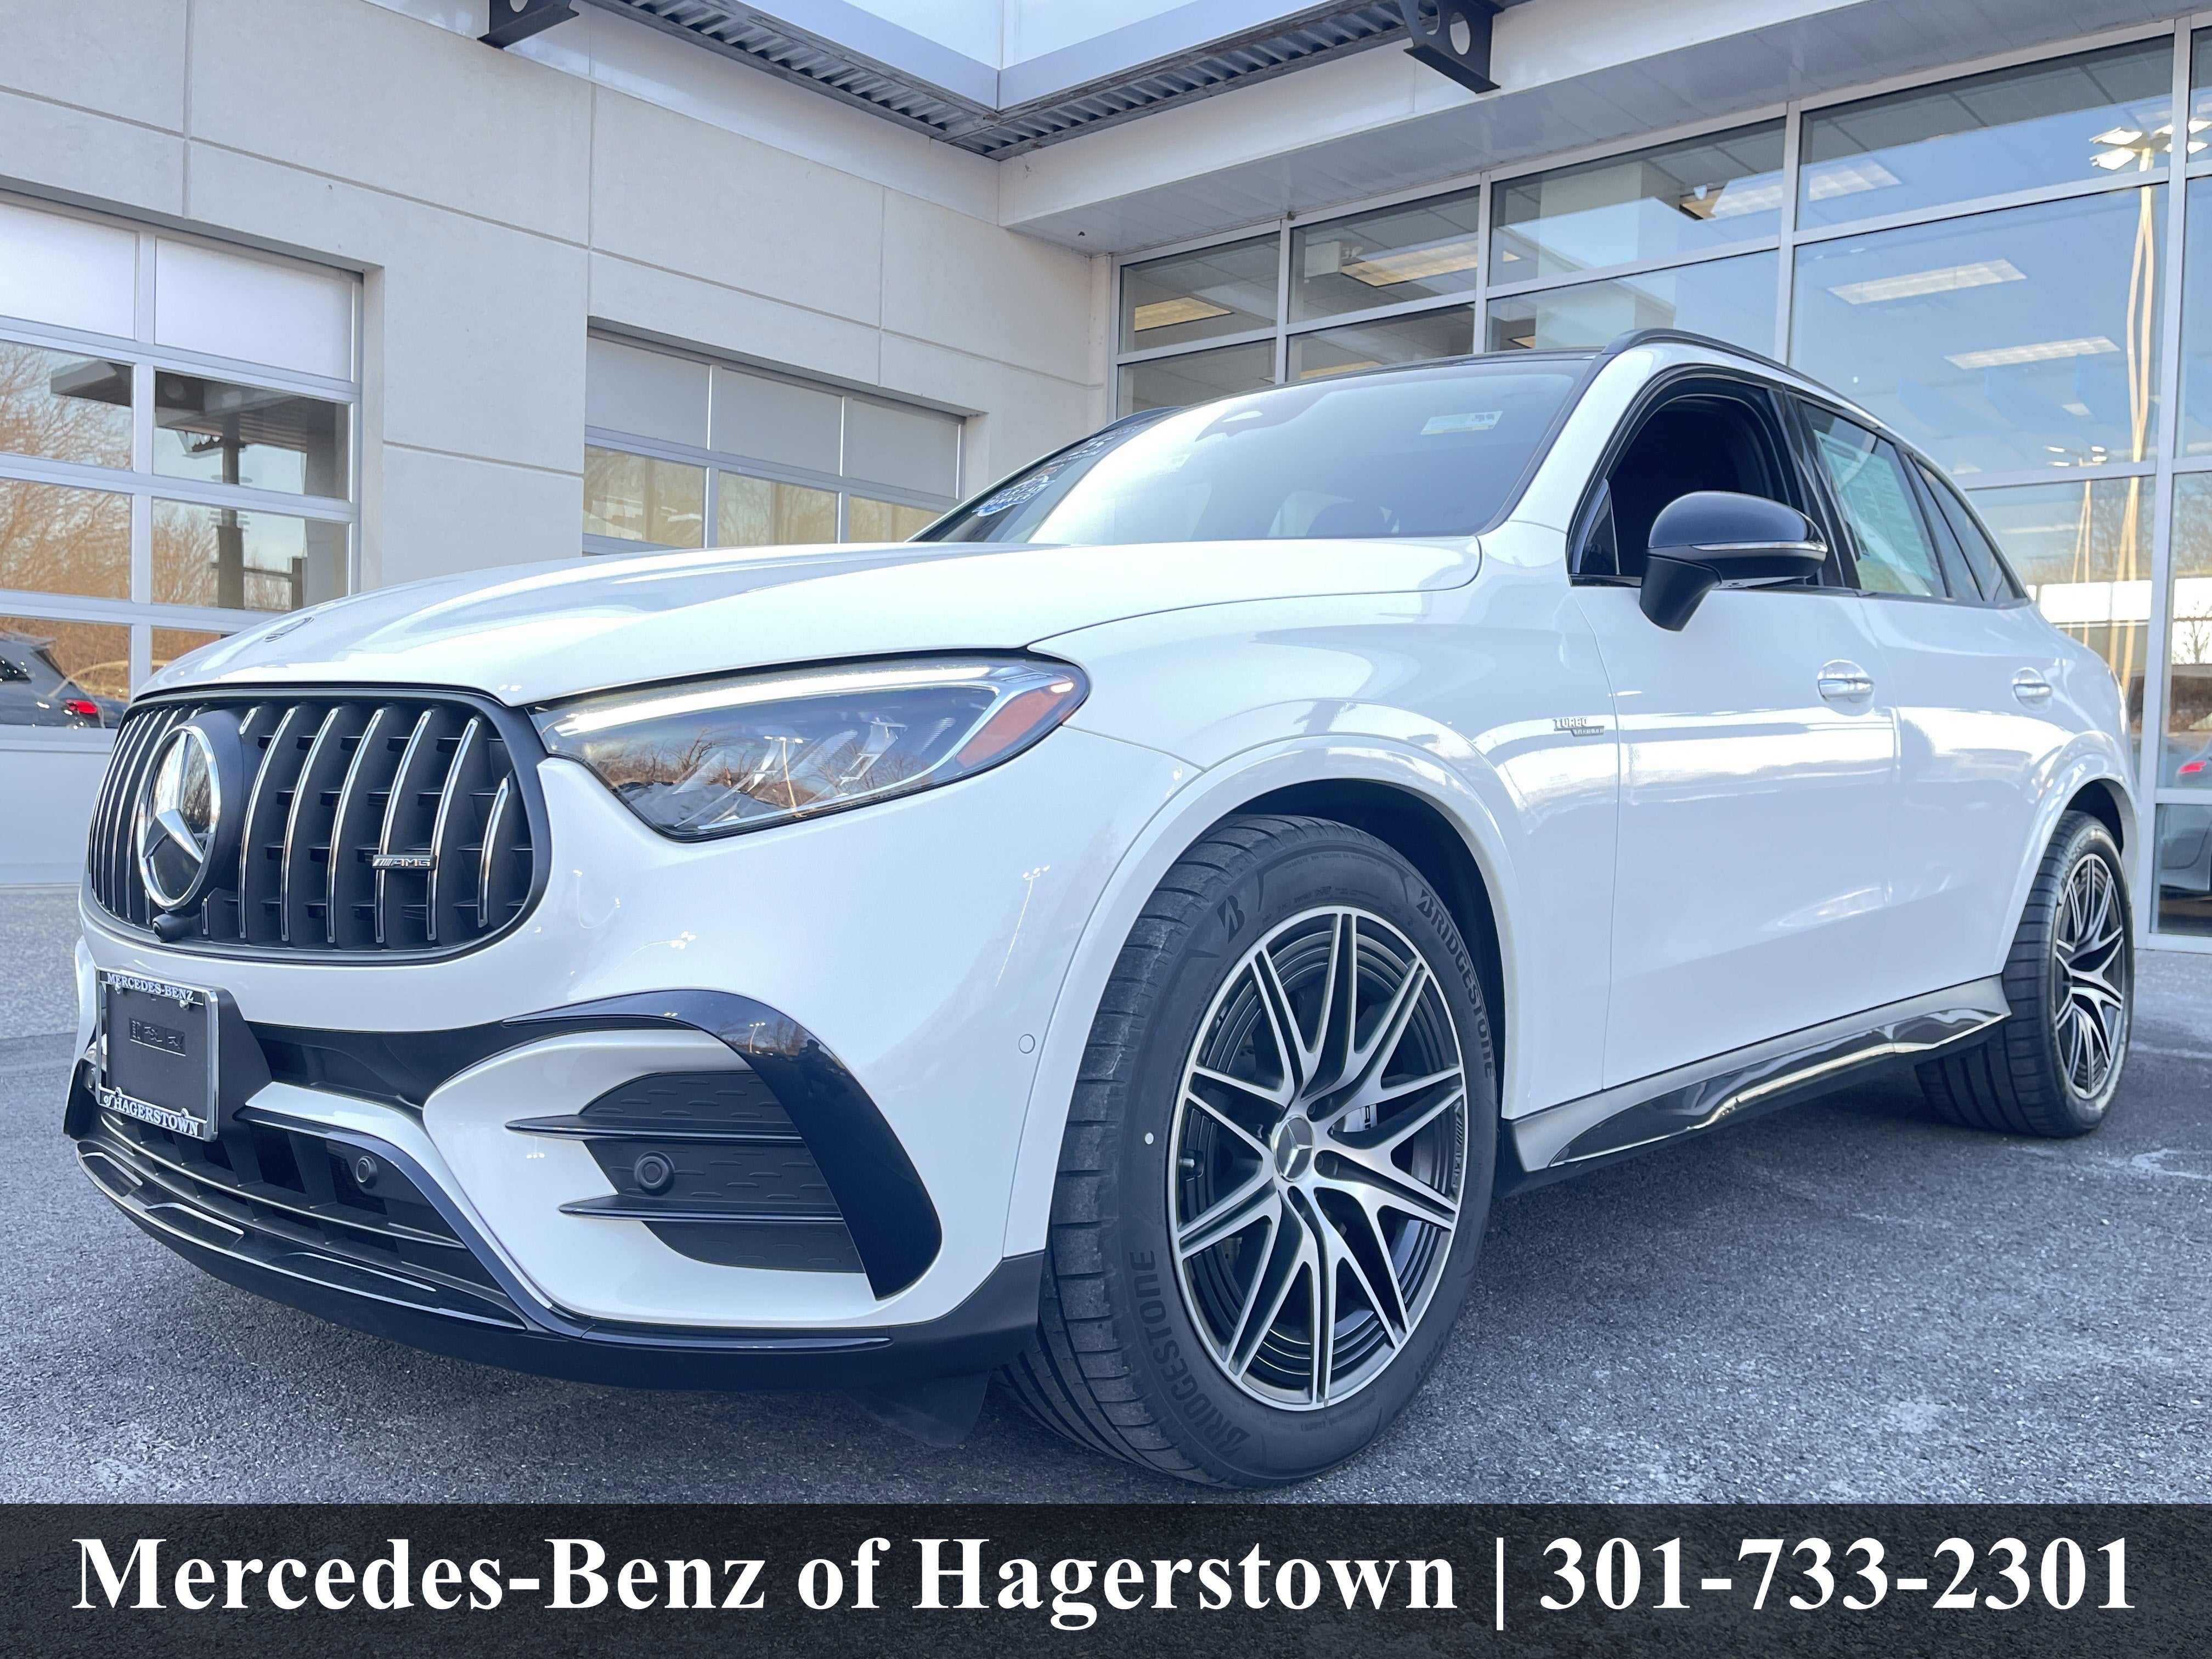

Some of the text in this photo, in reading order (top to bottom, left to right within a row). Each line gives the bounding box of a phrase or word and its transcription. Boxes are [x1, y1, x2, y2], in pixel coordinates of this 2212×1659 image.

[107, 973, 194, 1001] MERCEDES-BENZ
[1417, 888, 1494, 1079] BRIDGESTONE
[103, 1094, 199, 1136] of HAGERSTOWN
[1130, 1250, 1251, 1457] BRIDGESTONE
